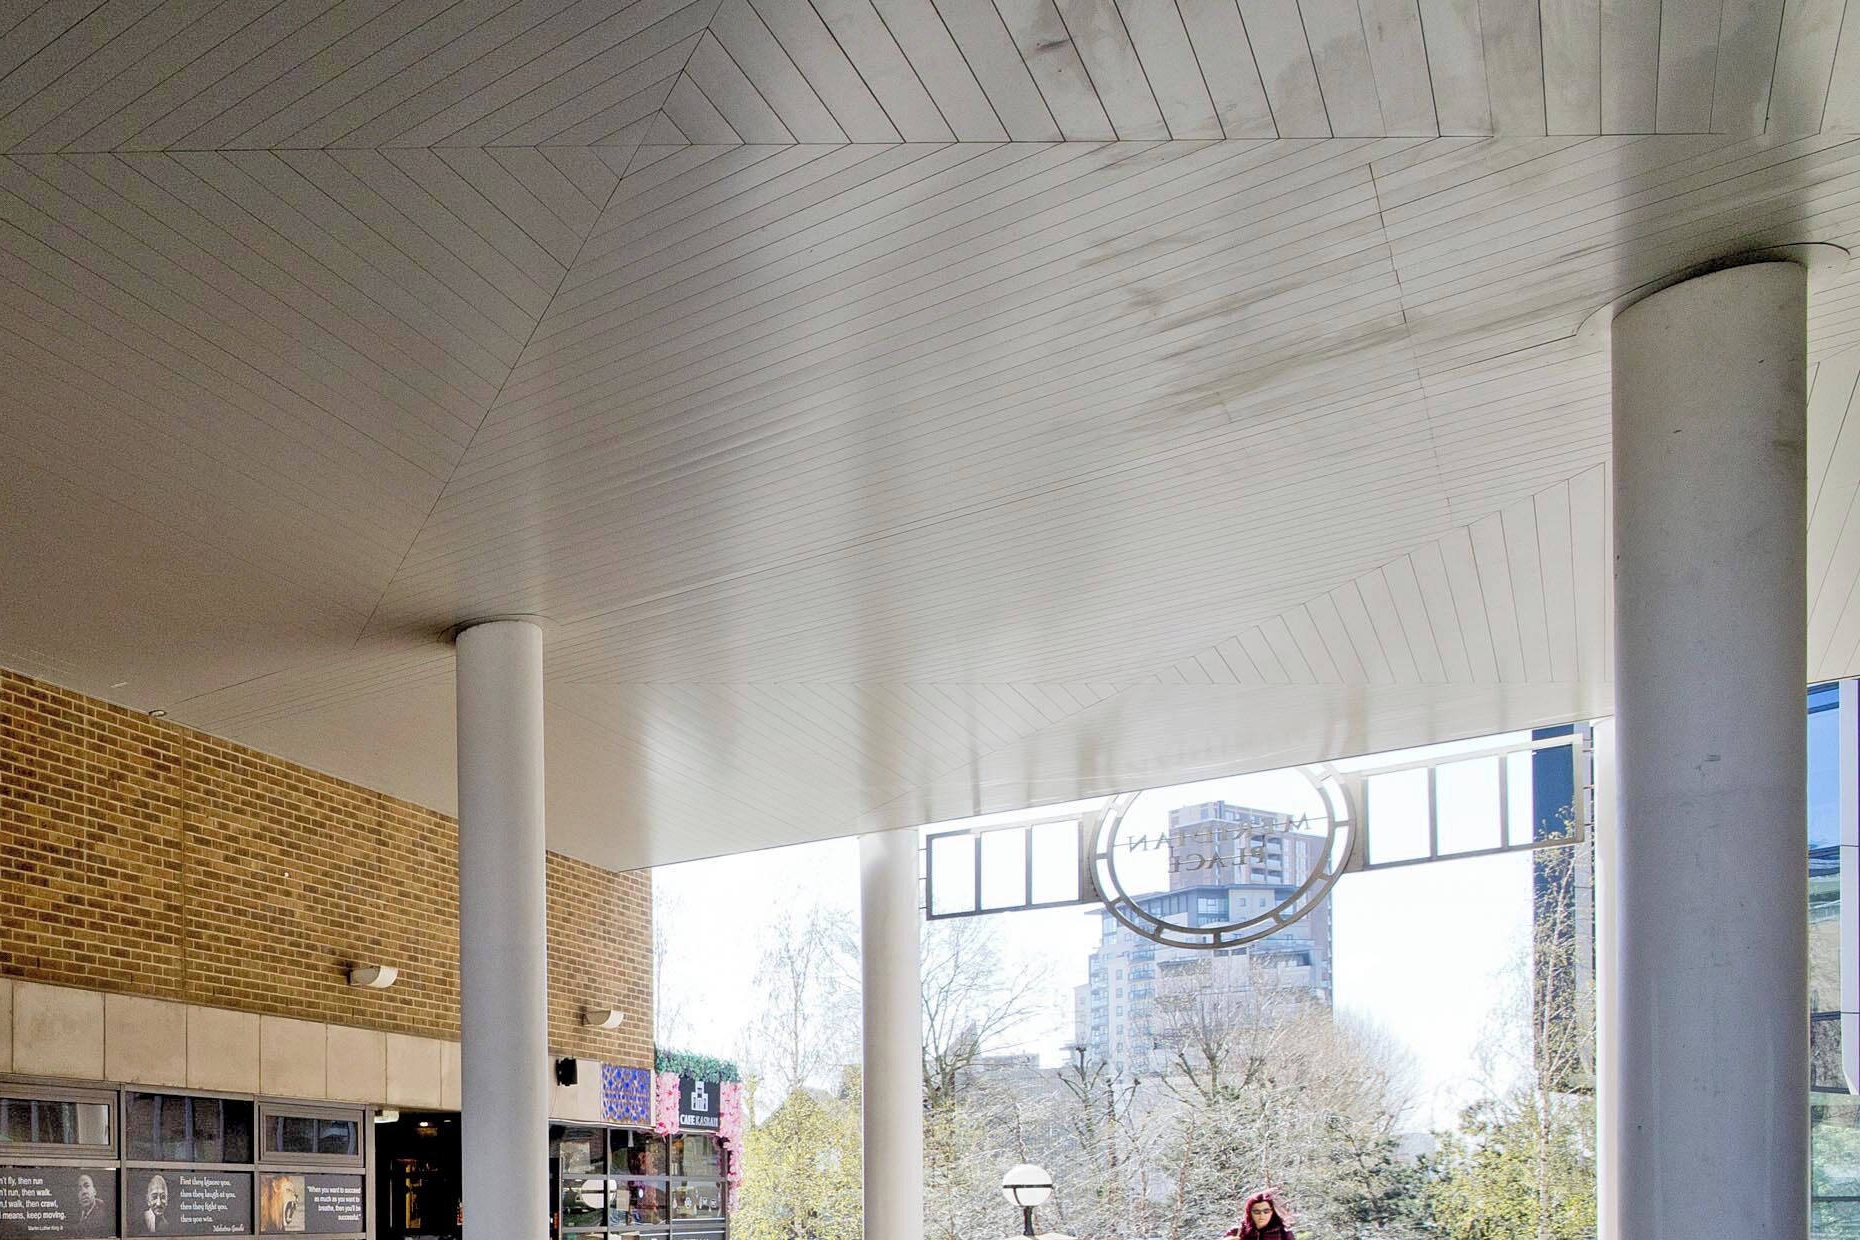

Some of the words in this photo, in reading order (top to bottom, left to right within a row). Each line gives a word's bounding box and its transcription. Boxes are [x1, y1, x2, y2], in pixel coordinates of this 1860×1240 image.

[680, 1114, 696, 1126] CAFE
[8, 1176, 17, 1186] fly,
[27, 1212, 41, 1221] keep
[43, 1211, 66, 1220] moving.
